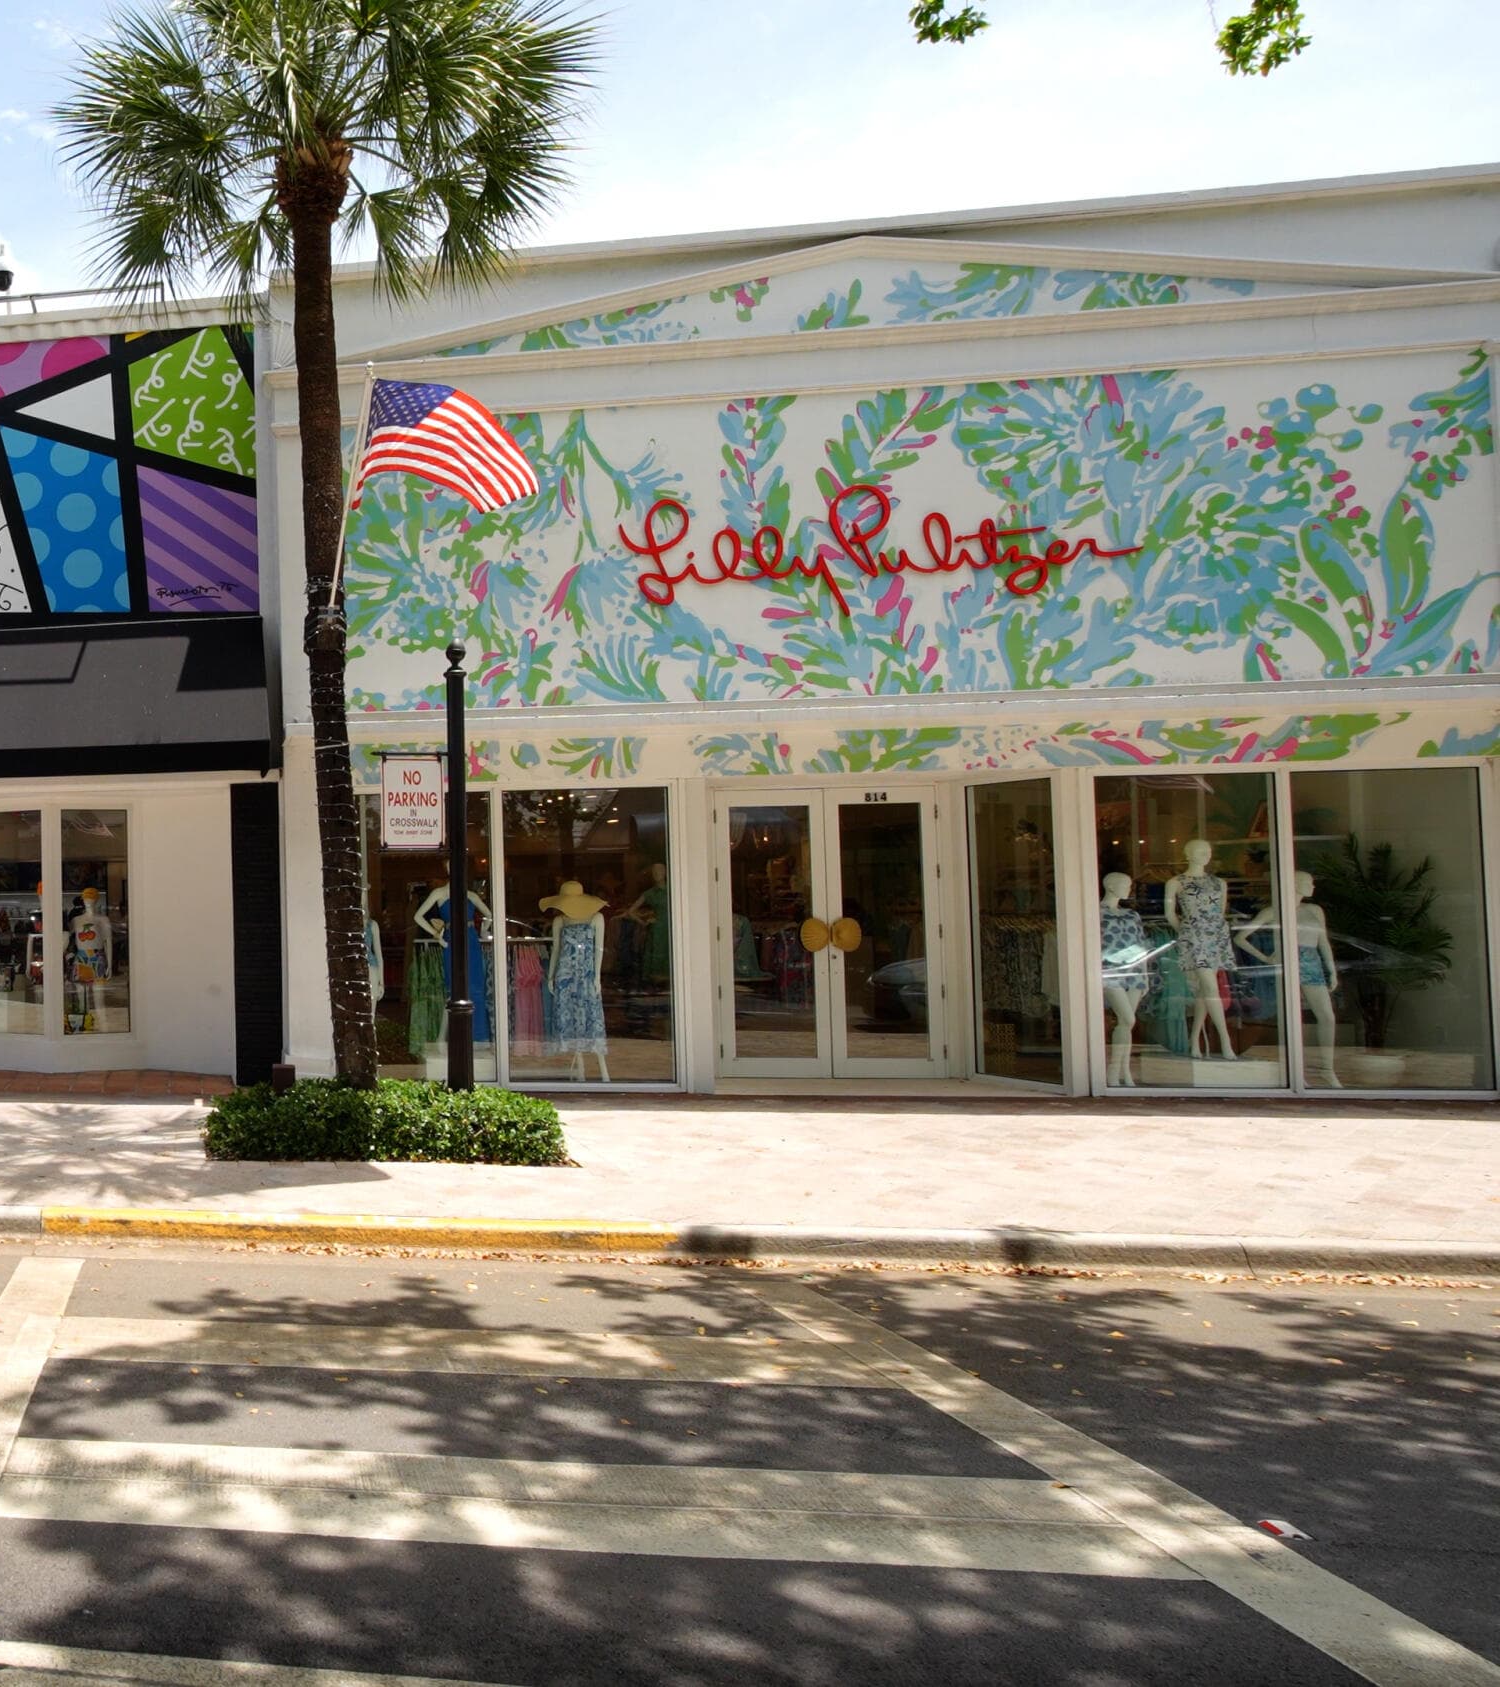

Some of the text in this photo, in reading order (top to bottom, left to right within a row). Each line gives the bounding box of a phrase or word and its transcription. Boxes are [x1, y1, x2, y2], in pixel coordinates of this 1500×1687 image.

[618, 484, 1144, 617] Lilly Pulitzer
[403, 770, 422, 785] NO
[388, 791, 438, 807] PARKING
[865, 792, 887, 802] 814
[390, 817, 438, 827] CROSSWALK
